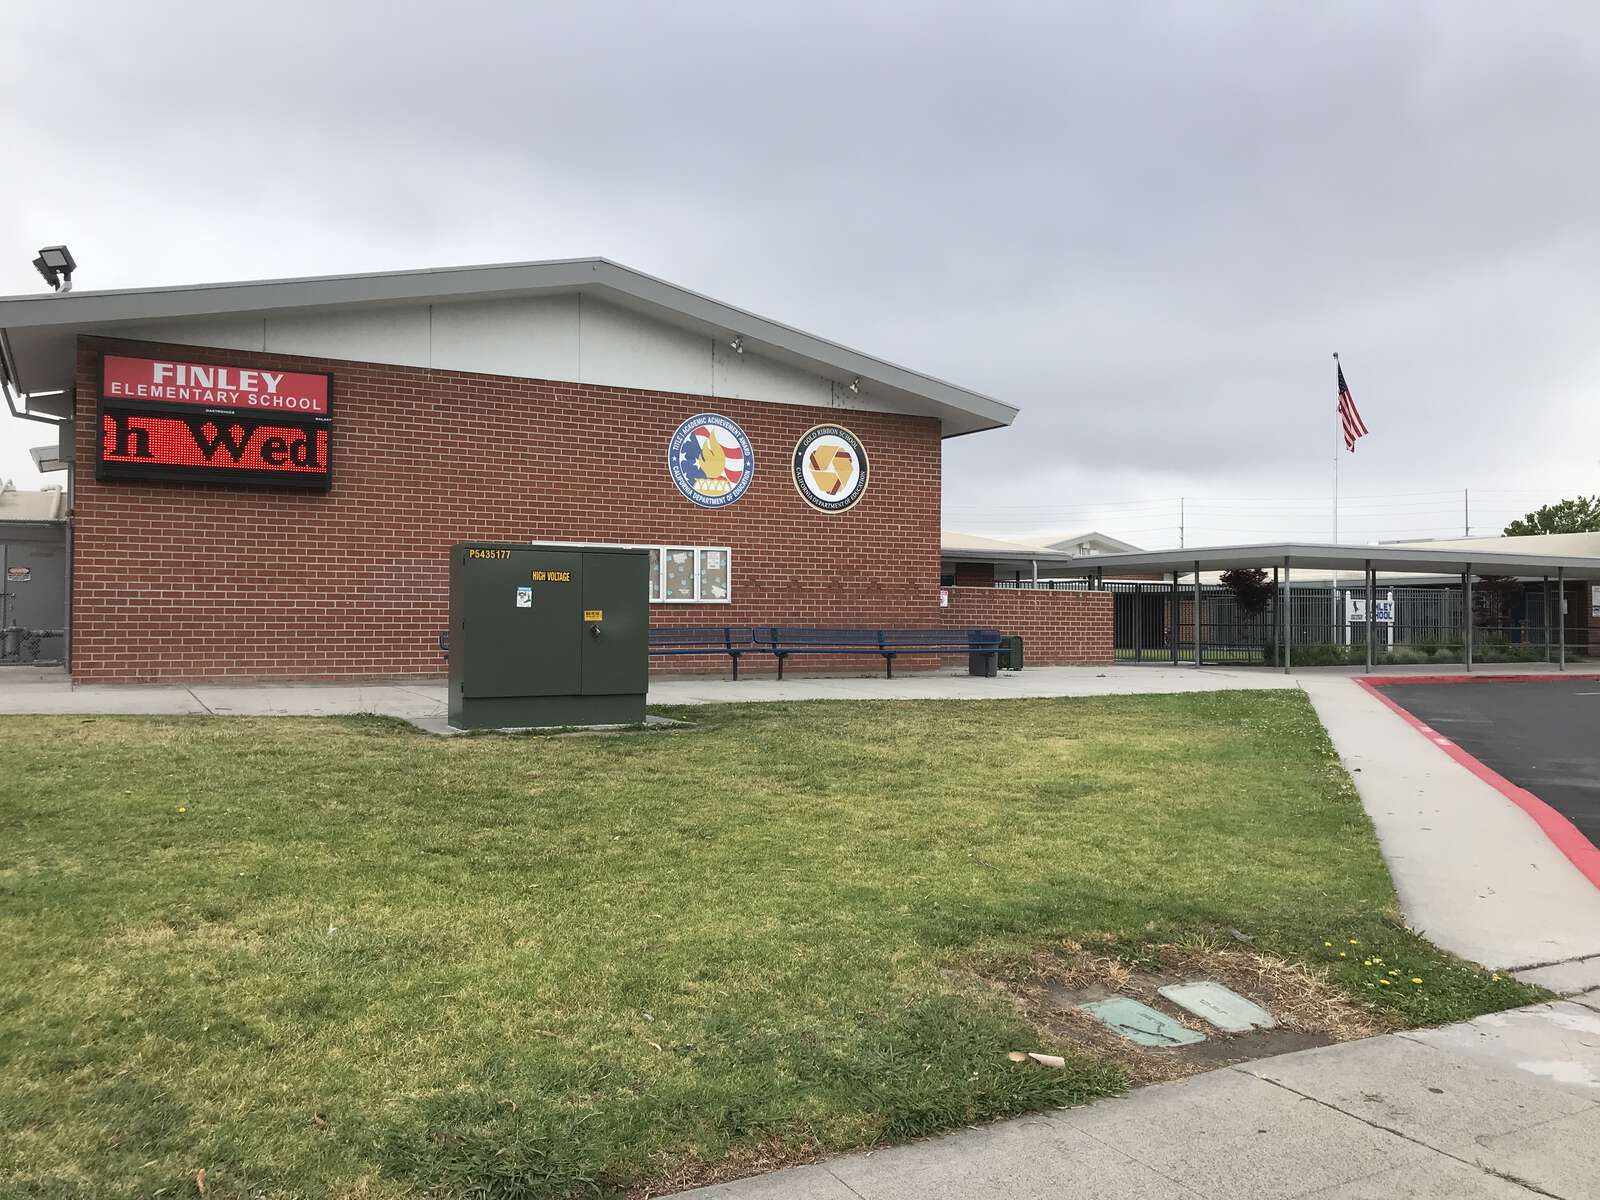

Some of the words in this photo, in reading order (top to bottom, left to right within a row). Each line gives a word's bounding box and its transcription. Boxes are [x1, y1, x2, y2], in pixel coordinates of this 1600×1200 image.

[152, 362, 284, 394] FINLEY
[111, 381, 240, 404] ELEMENTARY
[248, 393, 322, 411] SCHOOL
[104, 415, 155, 457] h
[183, 419, 323, 468] Wed
[673, 436, 683, 451] TITLE
[682, 417, 707, 435] ACADEMIC
[708, 416, 741, 438] ACHIEVEMENT
[739, 436, 751, 457] AWARD
[803, 432, 817, 447] GOLD
[817, 428, 839, 436] RIBBON
[839, 430, 859, 450] SCHOOL
[673, 465, 693, 496] CALIFORNIA
[692, 491, 726, 505] DEPARTMENT
[726, 493, 734, 502] OF
[733, 470, 751, 496] EDUCATION
[796, 467, 814, 502] CALIFORNIA
[812, 498, 845, 509] DEPARTMENT
[851, 471, 866, 501] EDUCATION
[469, 549, 511, 559] P5435177
[532, 570, 546, 581] HIGH
[547, 571, 570, 582] VOLTAGE
